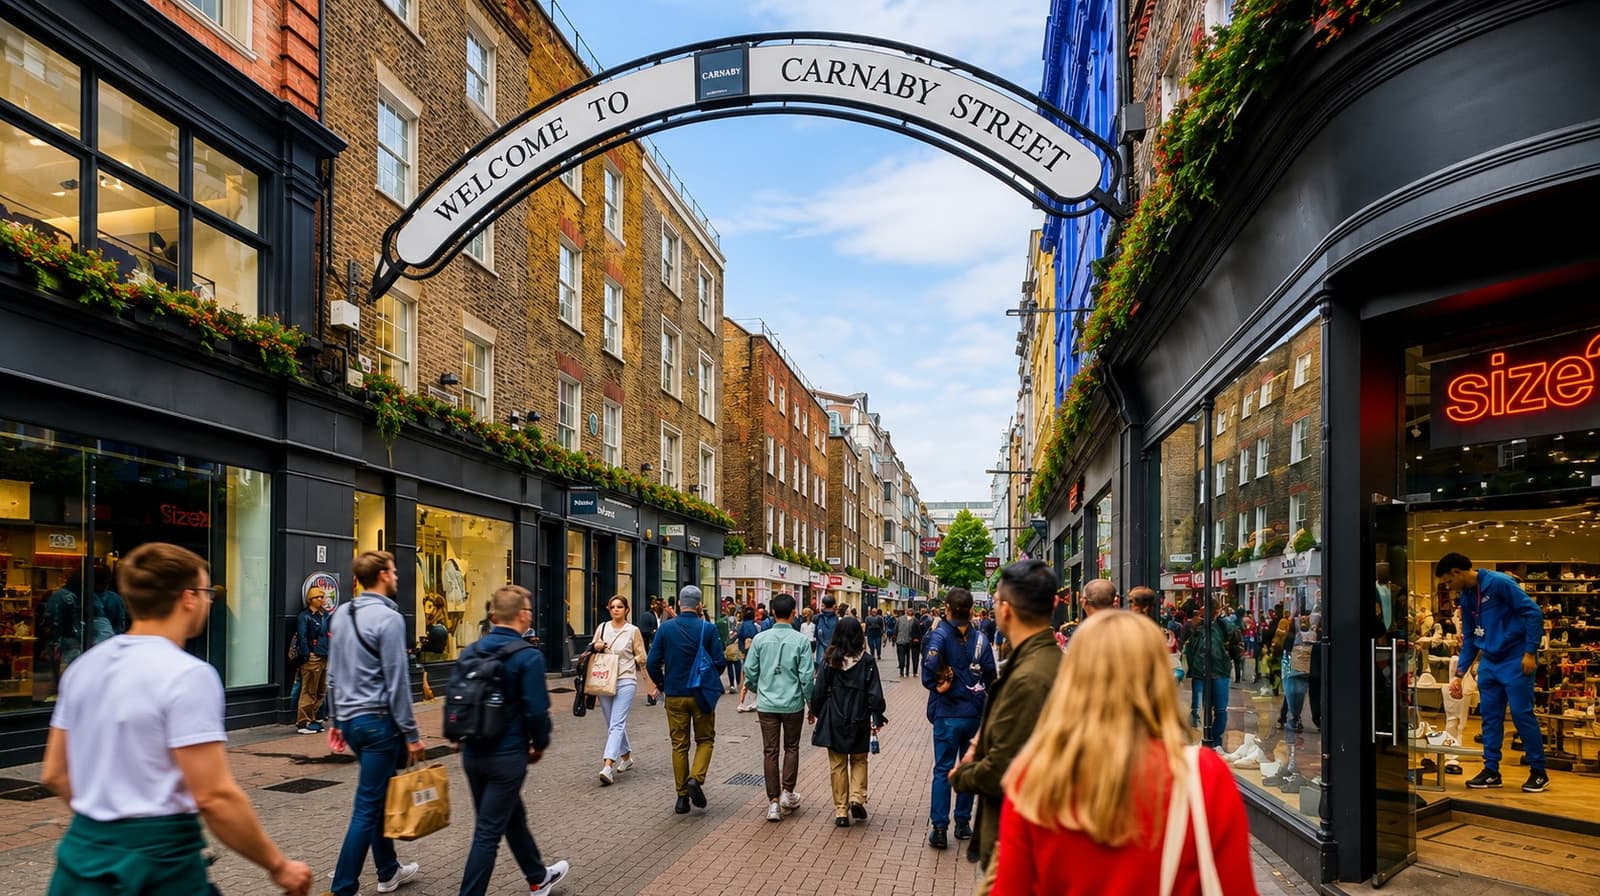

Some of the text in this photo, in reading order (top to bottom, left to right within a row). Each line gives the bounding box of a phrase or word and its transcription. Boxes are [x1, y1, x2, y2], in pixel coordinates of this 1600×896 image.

[702, 67, 742, 80] CARNABY
[781, 57, 1071, 172] CARNABY STREET
[433, 91, 629, 221] WELCOME TO
